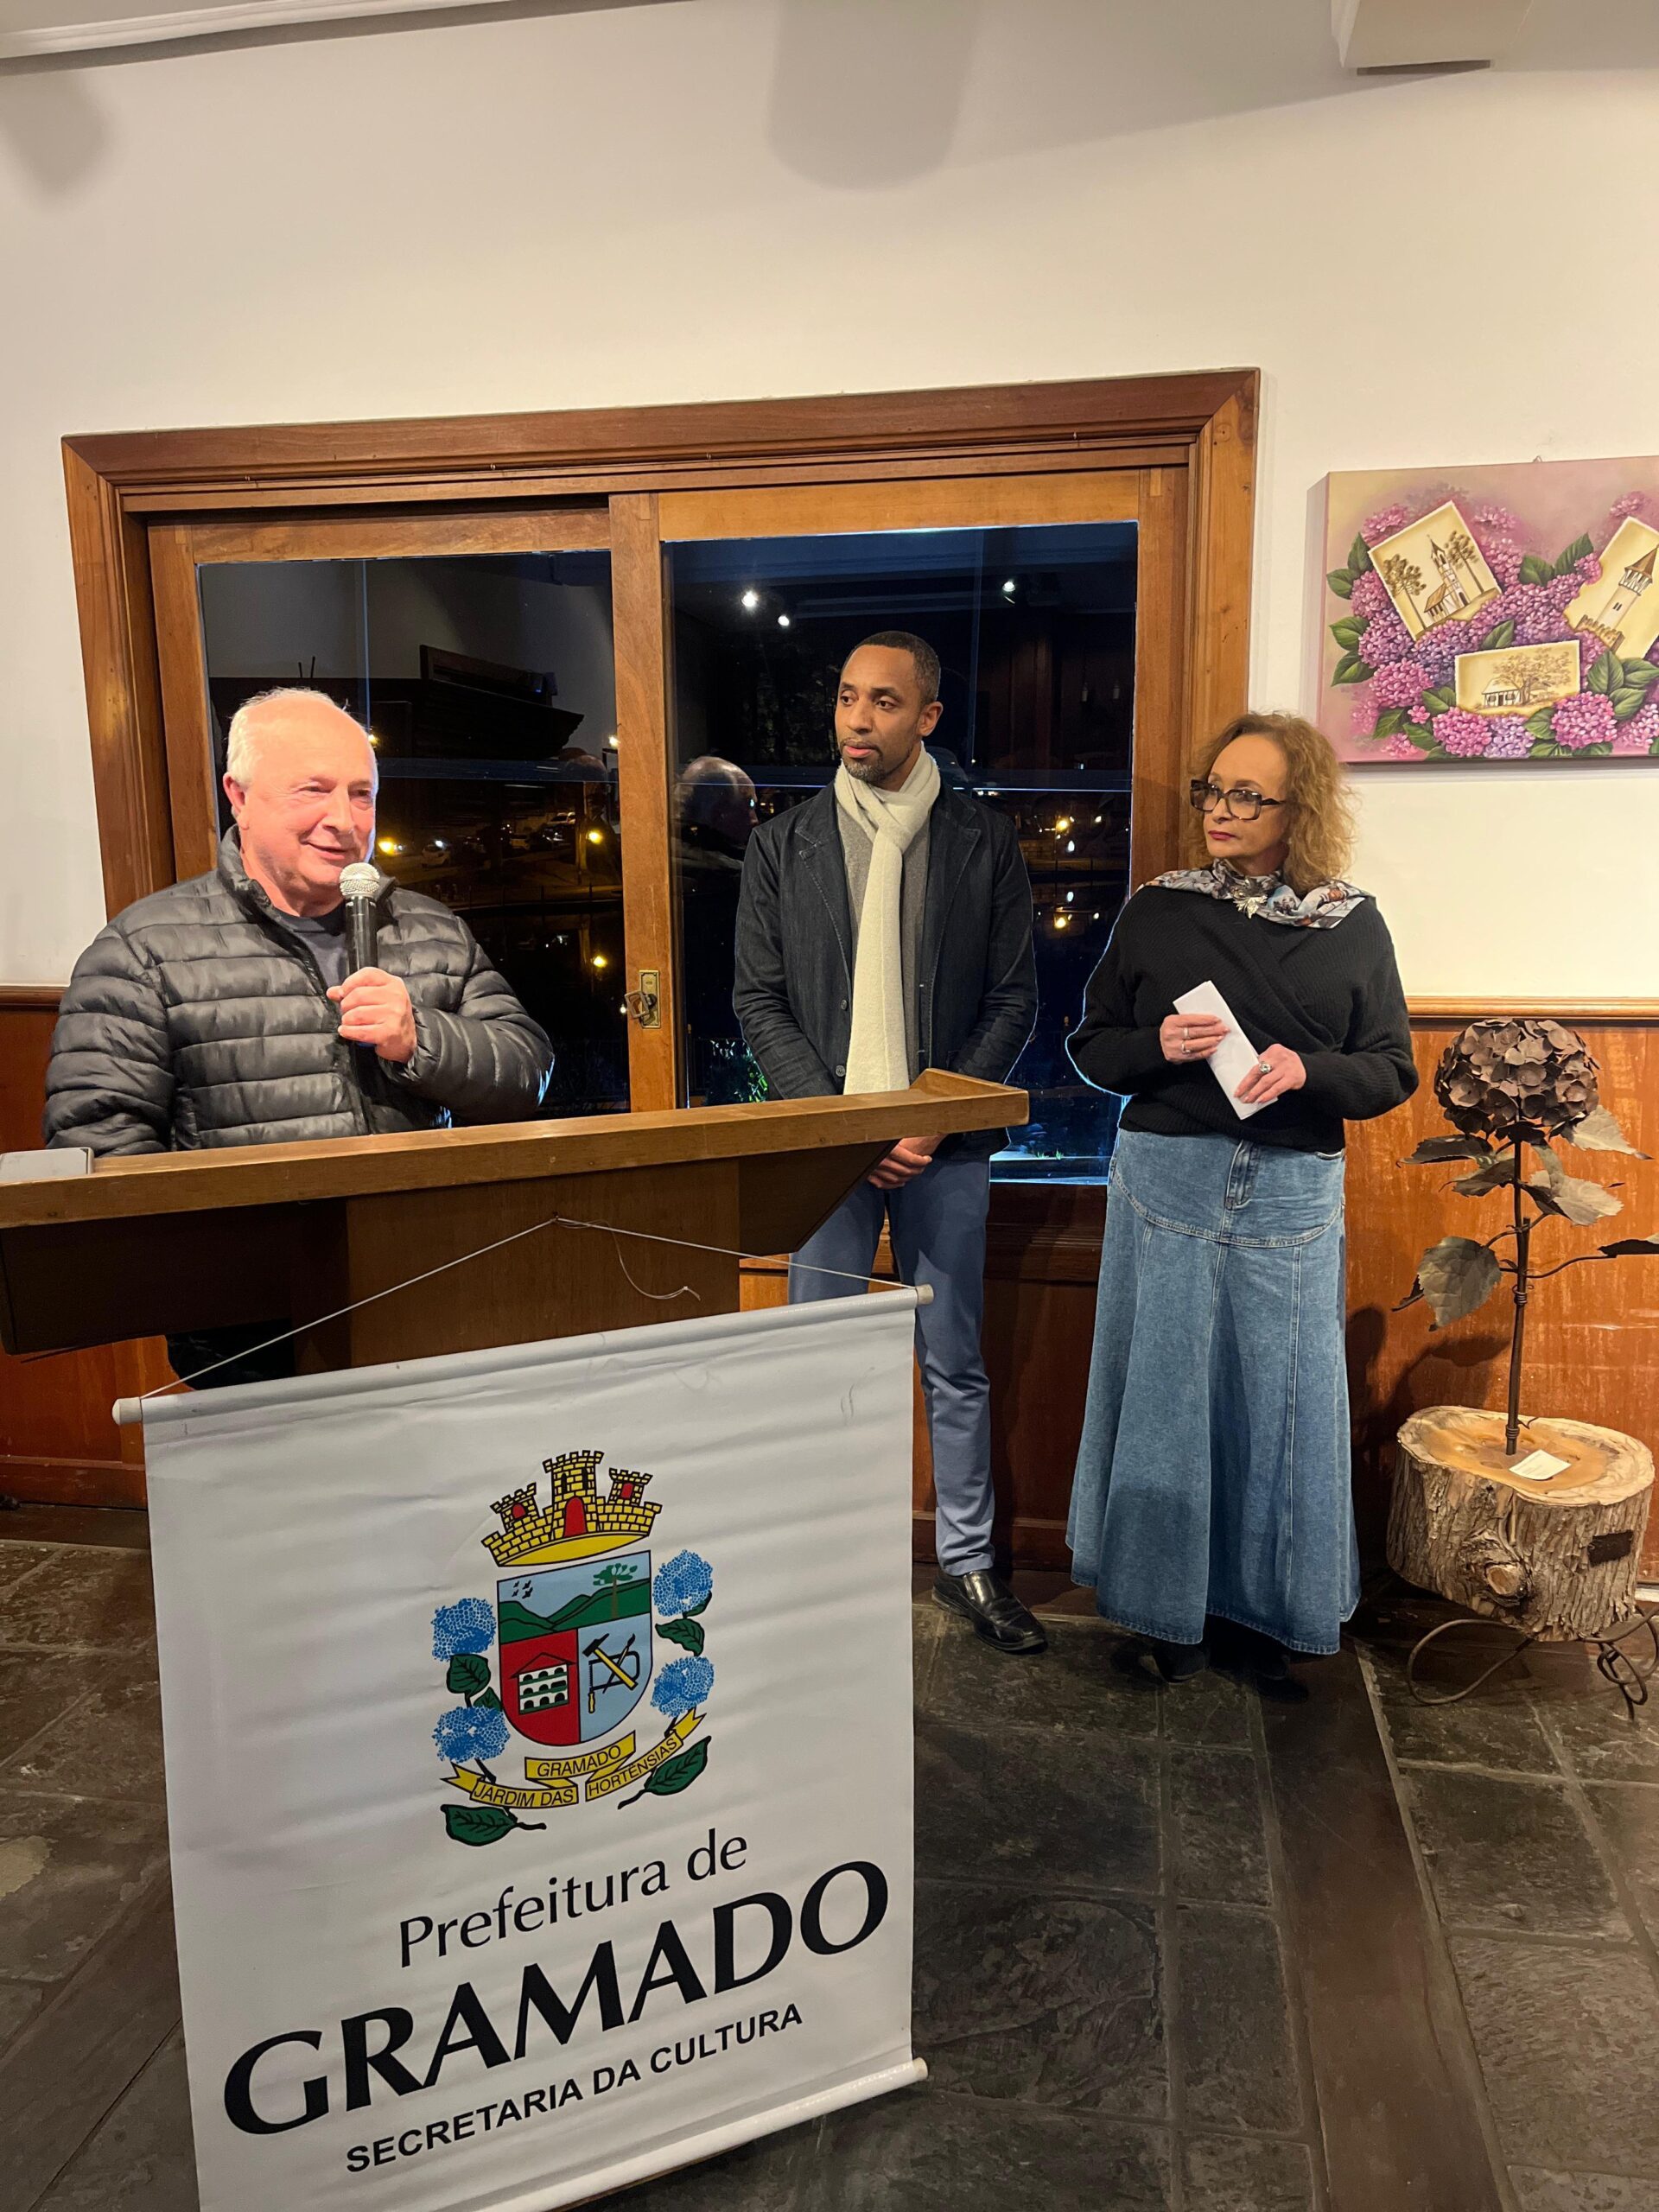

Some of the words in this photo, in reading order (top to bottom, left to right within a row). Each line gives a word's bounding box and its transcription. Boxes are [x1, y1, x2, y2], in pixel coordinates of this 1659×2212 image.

[474, 1784, 534, 1807] JARDIM
[541, 1789, 574, 1806] DAS
[588, 1738, 677, 1796] HORTÊNSIAS
[537, 1745, 620, 1777] GRAMADO
[400, 1861, 671, 1968] Prefeitura
[688, 1828, 747, 1881] de
[224, 1860, 888, 2135] GRAMADO
[346, 2079, 583, 2173] SECRETARIA
[594, 2059, 641, 2095] DA
[651, 2004, 803, 2074] CULTURA
